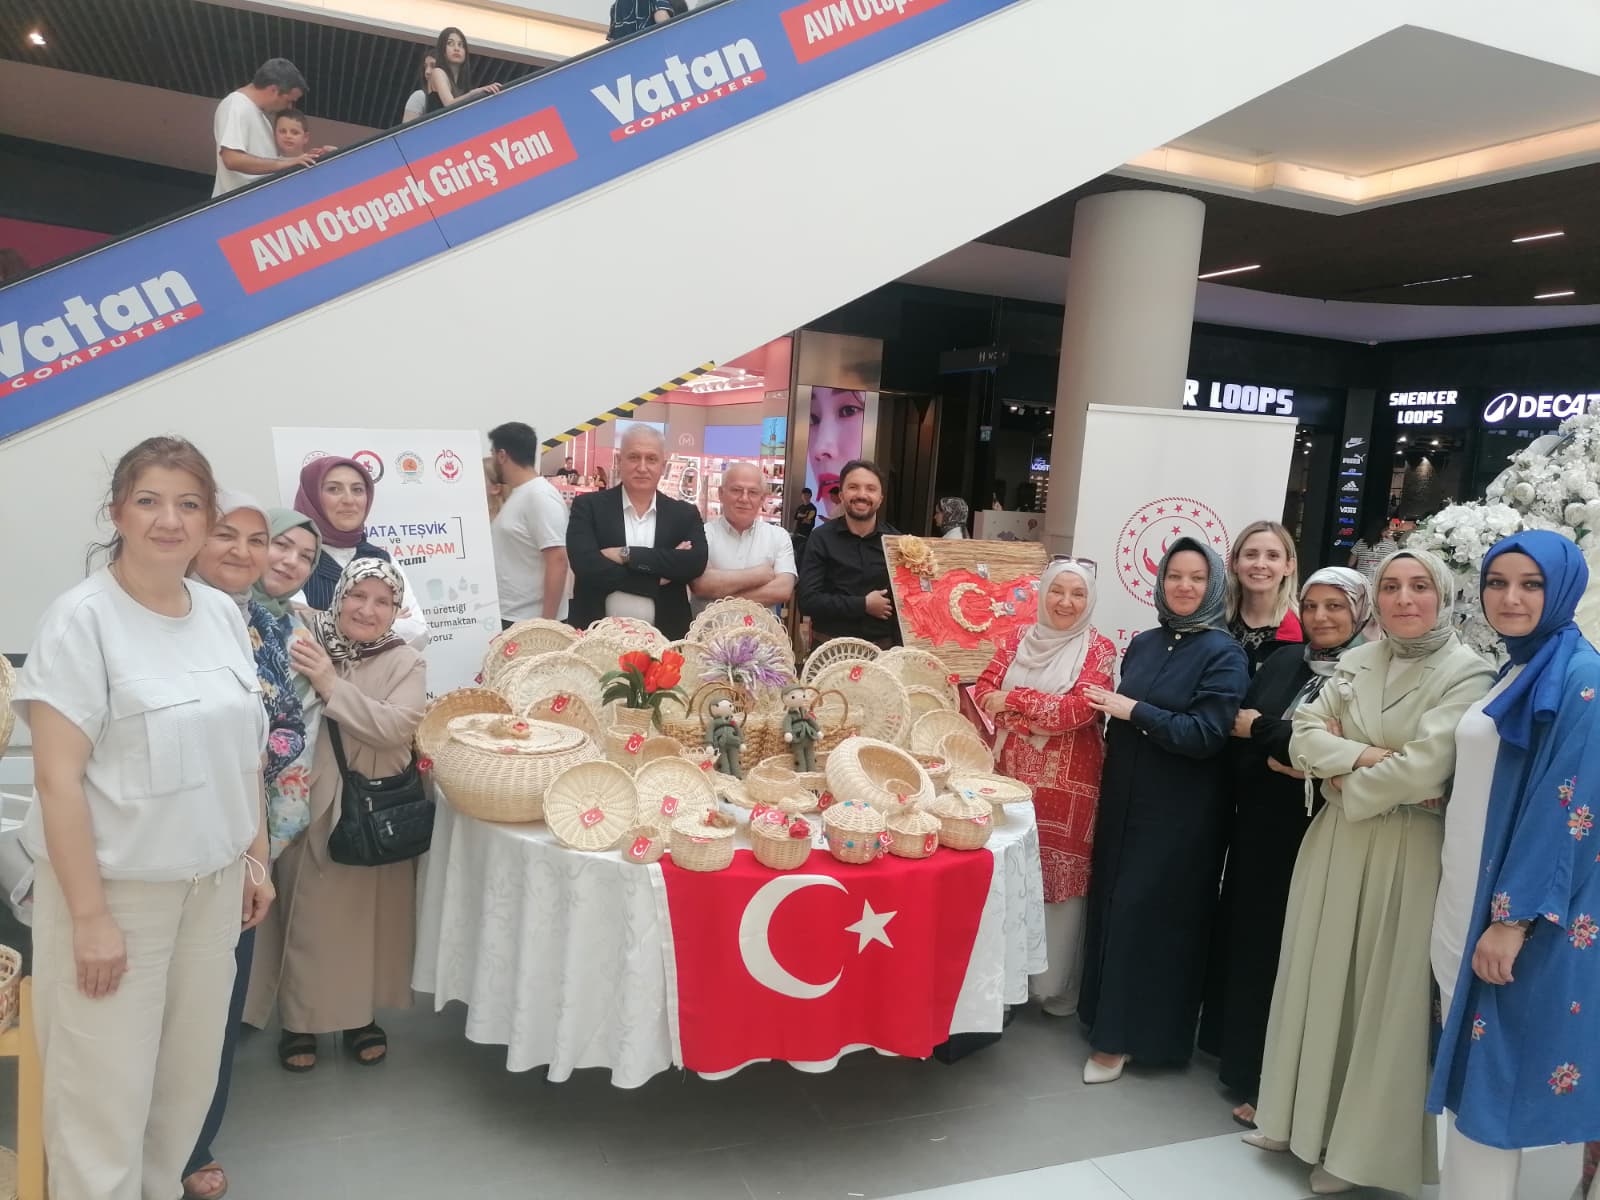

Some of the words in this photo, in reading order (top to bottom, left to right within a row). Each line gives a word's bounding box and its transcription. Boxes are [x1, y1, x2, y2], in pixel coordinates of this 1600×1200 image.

[803, 1, 855, 44] AVM
[590, 38, 762, 125] Vatan
[624, 76, 753, 135] COMPUTER
[250, 219, 321, 272] AVM
[316, 175, 434, 232] Otopark
[429, 150, 497, 186] Giriş
[490, 130, 554, 170] Yanı
[11, 312, 187, 388] COMPUTER
[1209, 382, 1294, 415] LOOPS
[1389, 391, 1458, 407] SNEAKER
[1398, 409, 1443, 424] LOOPS
[400, 521, 447, 539] TEŞVİK
[406, 542, 455, 558] YAŞAM
